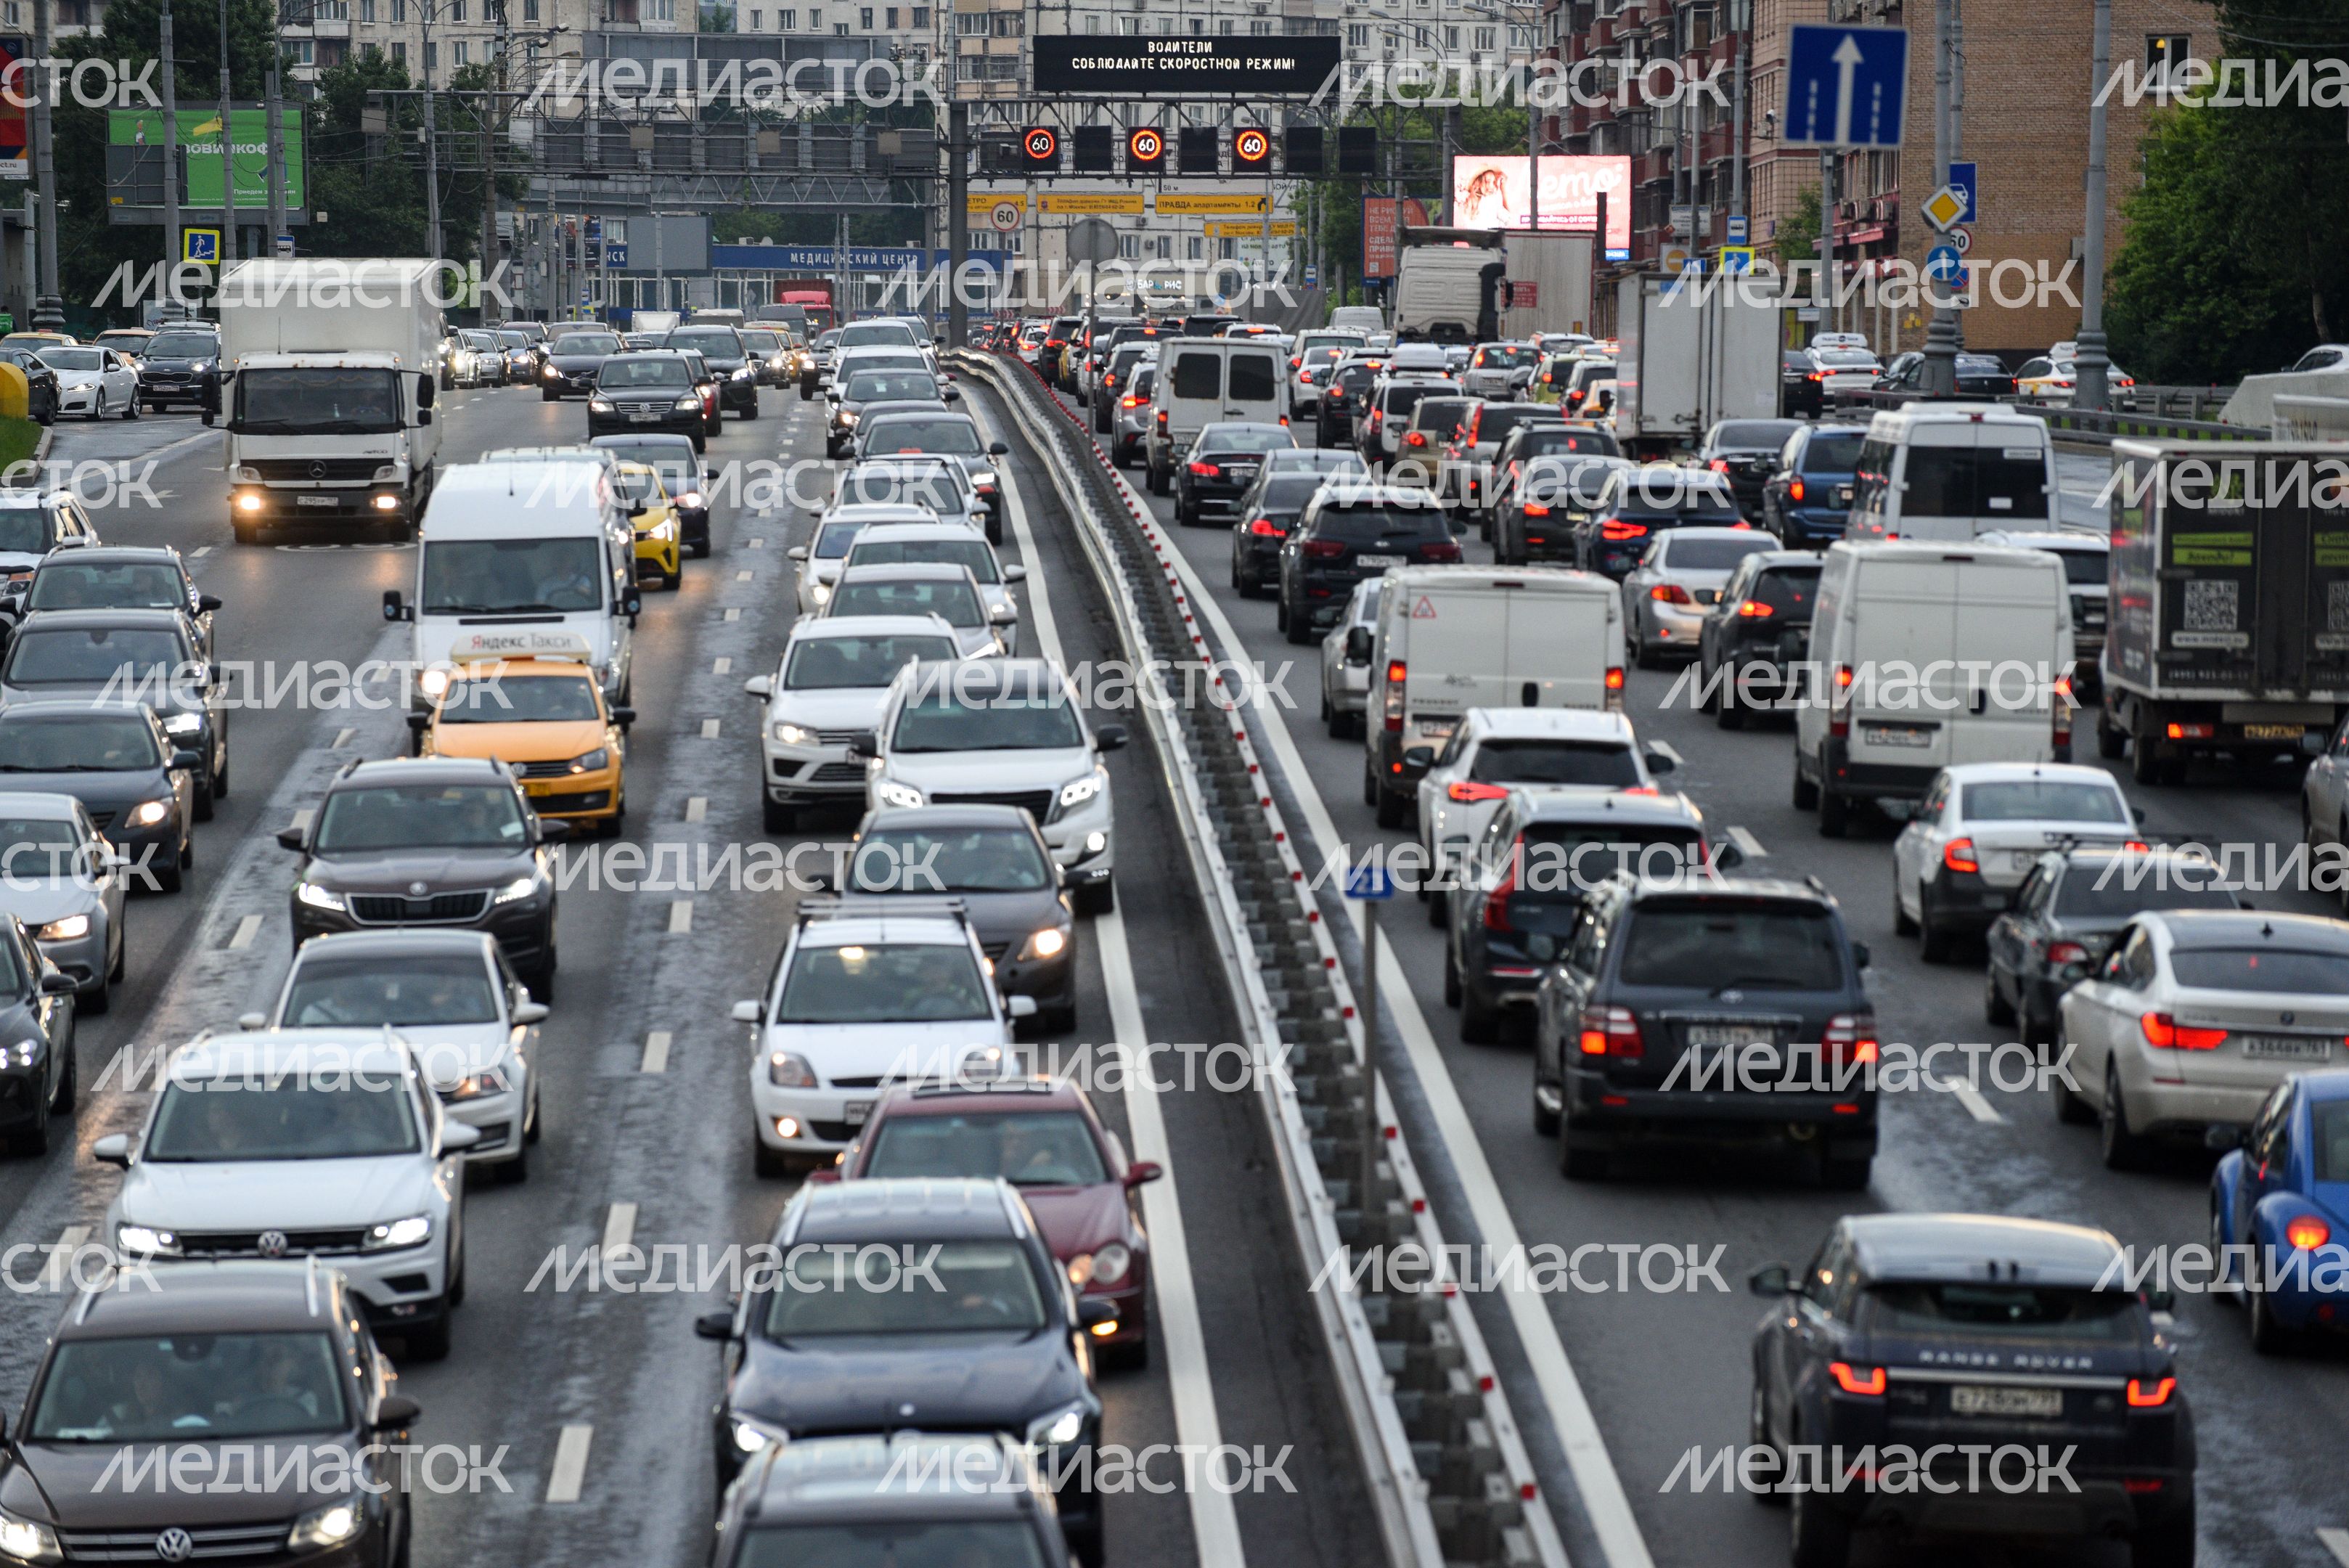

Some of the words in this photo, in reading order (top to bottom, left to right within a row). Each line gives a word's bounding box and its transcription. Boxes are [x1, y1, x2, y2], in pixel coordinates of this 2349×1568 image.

[1148, 41, 1212, 53] ВОДИТЕЛИ
[1072, 57, 1154, 70] СОБЛЮДАЙТЕ
[1159, 57, 1240, 70] СКОРОСТНОЙ
[1246, 57, 1295, 70] РЕЖИМ!
[1031, 138, 1049, 150] 60
[1138, 139, 1155, 152] 60
[1243, 139, 1261, 152] 60
[997, 210, 1013, 223] 60
[471, 635, 526, 649] Яндекс
[530, 634, 571, 648] Такси
[1919, 1349, 1999, 1365] RANGE
[2014, 1355, 2093, 1369] ROVER
